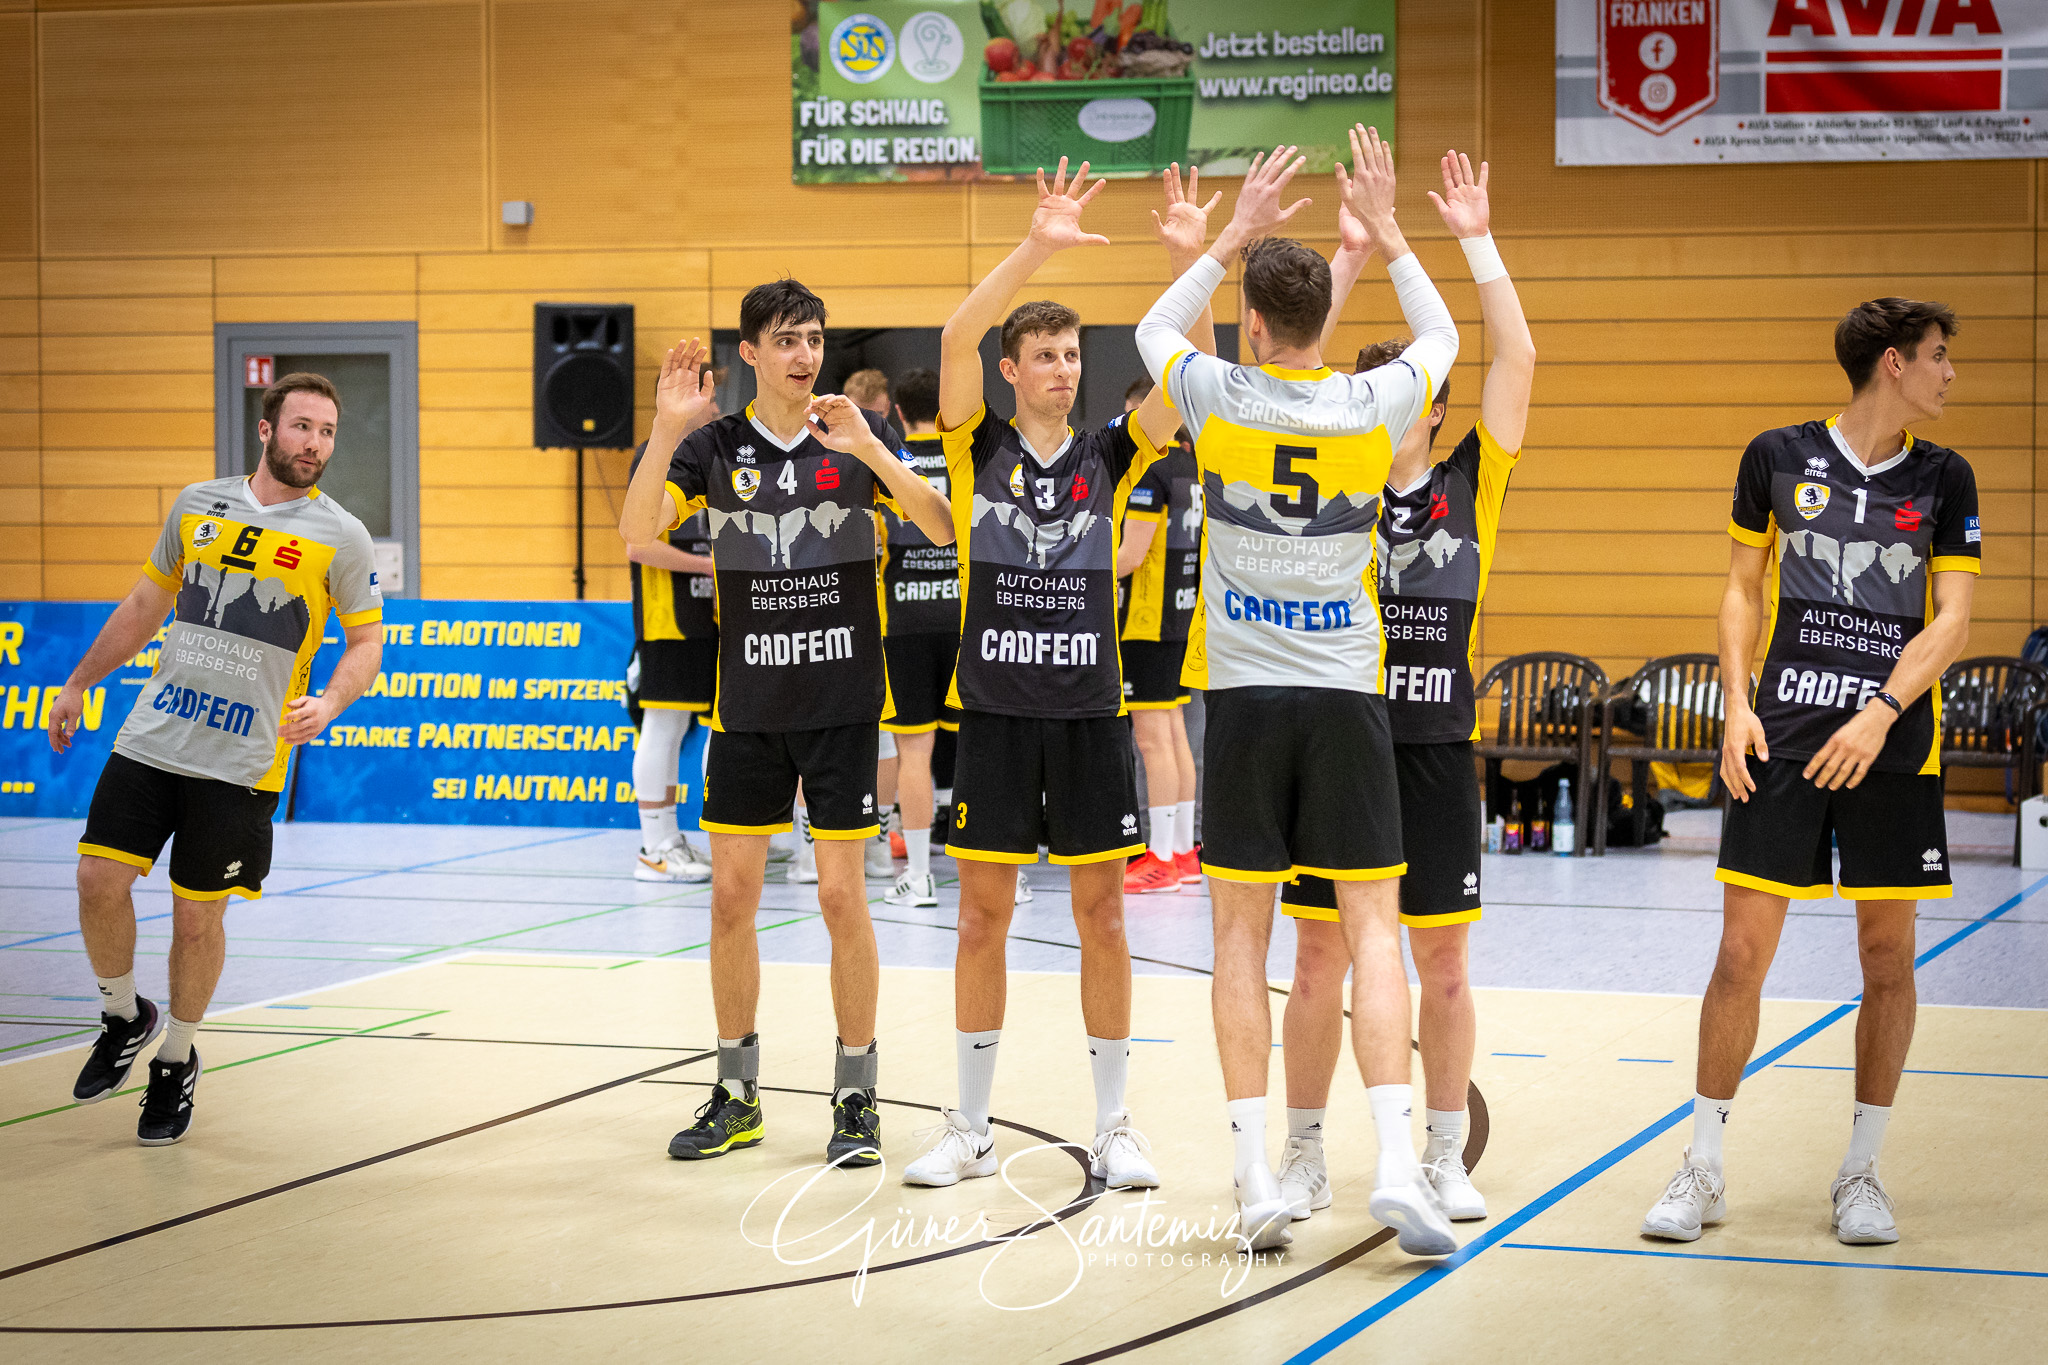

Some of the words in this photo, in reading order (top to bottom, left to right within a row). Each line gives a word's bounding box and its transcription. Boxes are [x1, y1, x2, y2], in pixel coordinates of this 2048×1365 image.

[1610, 1, 1705, 27] FRANKEN
[1767, 0, 2003, 37] AVIA
[1200, 32, 1268, 58] Jetzt
[1273, 27, 1384, 56] bestellen
[1200, 66, 1392, 101] www.regineo.de
[800, 95, 846, 127] FÜR
[850, 99, 949, 126] SCHWAIG.
[800, 133, 846, 165] FÜR
[851, 138, 888, 164] DIE
[893, 137, 980, 164] REGION.
[776, 460, 798, 495] 4
[1270, 444, 1319, 519] 5
[1034, 478, 1056, 511] 3
[1852, 488, 1868, 524] 1
[1391, 506, 1413, 533] 2
[231, 525, 264, 557] 6
[1238, 535, 1343, 557] AUTOHAUS
[751, 572, 839, 592] AUTOHAUS
[996, 572, 1087, 592] AUTOHAUS
[1235, 555, 1340, 578] EBERSBERG
[752, 591, 840, 610] EBERSBERG
[996, 591, 1086, 610] EBERSBERG
[1225, 589, 1352, 631] CADFEM
[421, 621, 582, 647] EMOTIONEN
[1802, 609, 1902, 639] AUTOHAUS
[178, 630, 264, 663] AUTOHAUS
[744, 626, 853, 666] CADFEM
[981, 628, 1097, 666] CADFEM
[1800, 629, 1902, 659] EBERSBERG
[175, 649, 258, 681] EBERSBERG
[488, 679, 517, 699] IM
[1384, 665, 1452, 703] FEM
[153, 683, 256, 737] CADFEM
[329, 726, 413, 748] STARKE
[432, 777, 467, 799] SEI
[475, 775, 608, 802] HAUTNAH
[956, 802, 968, 829] 3
